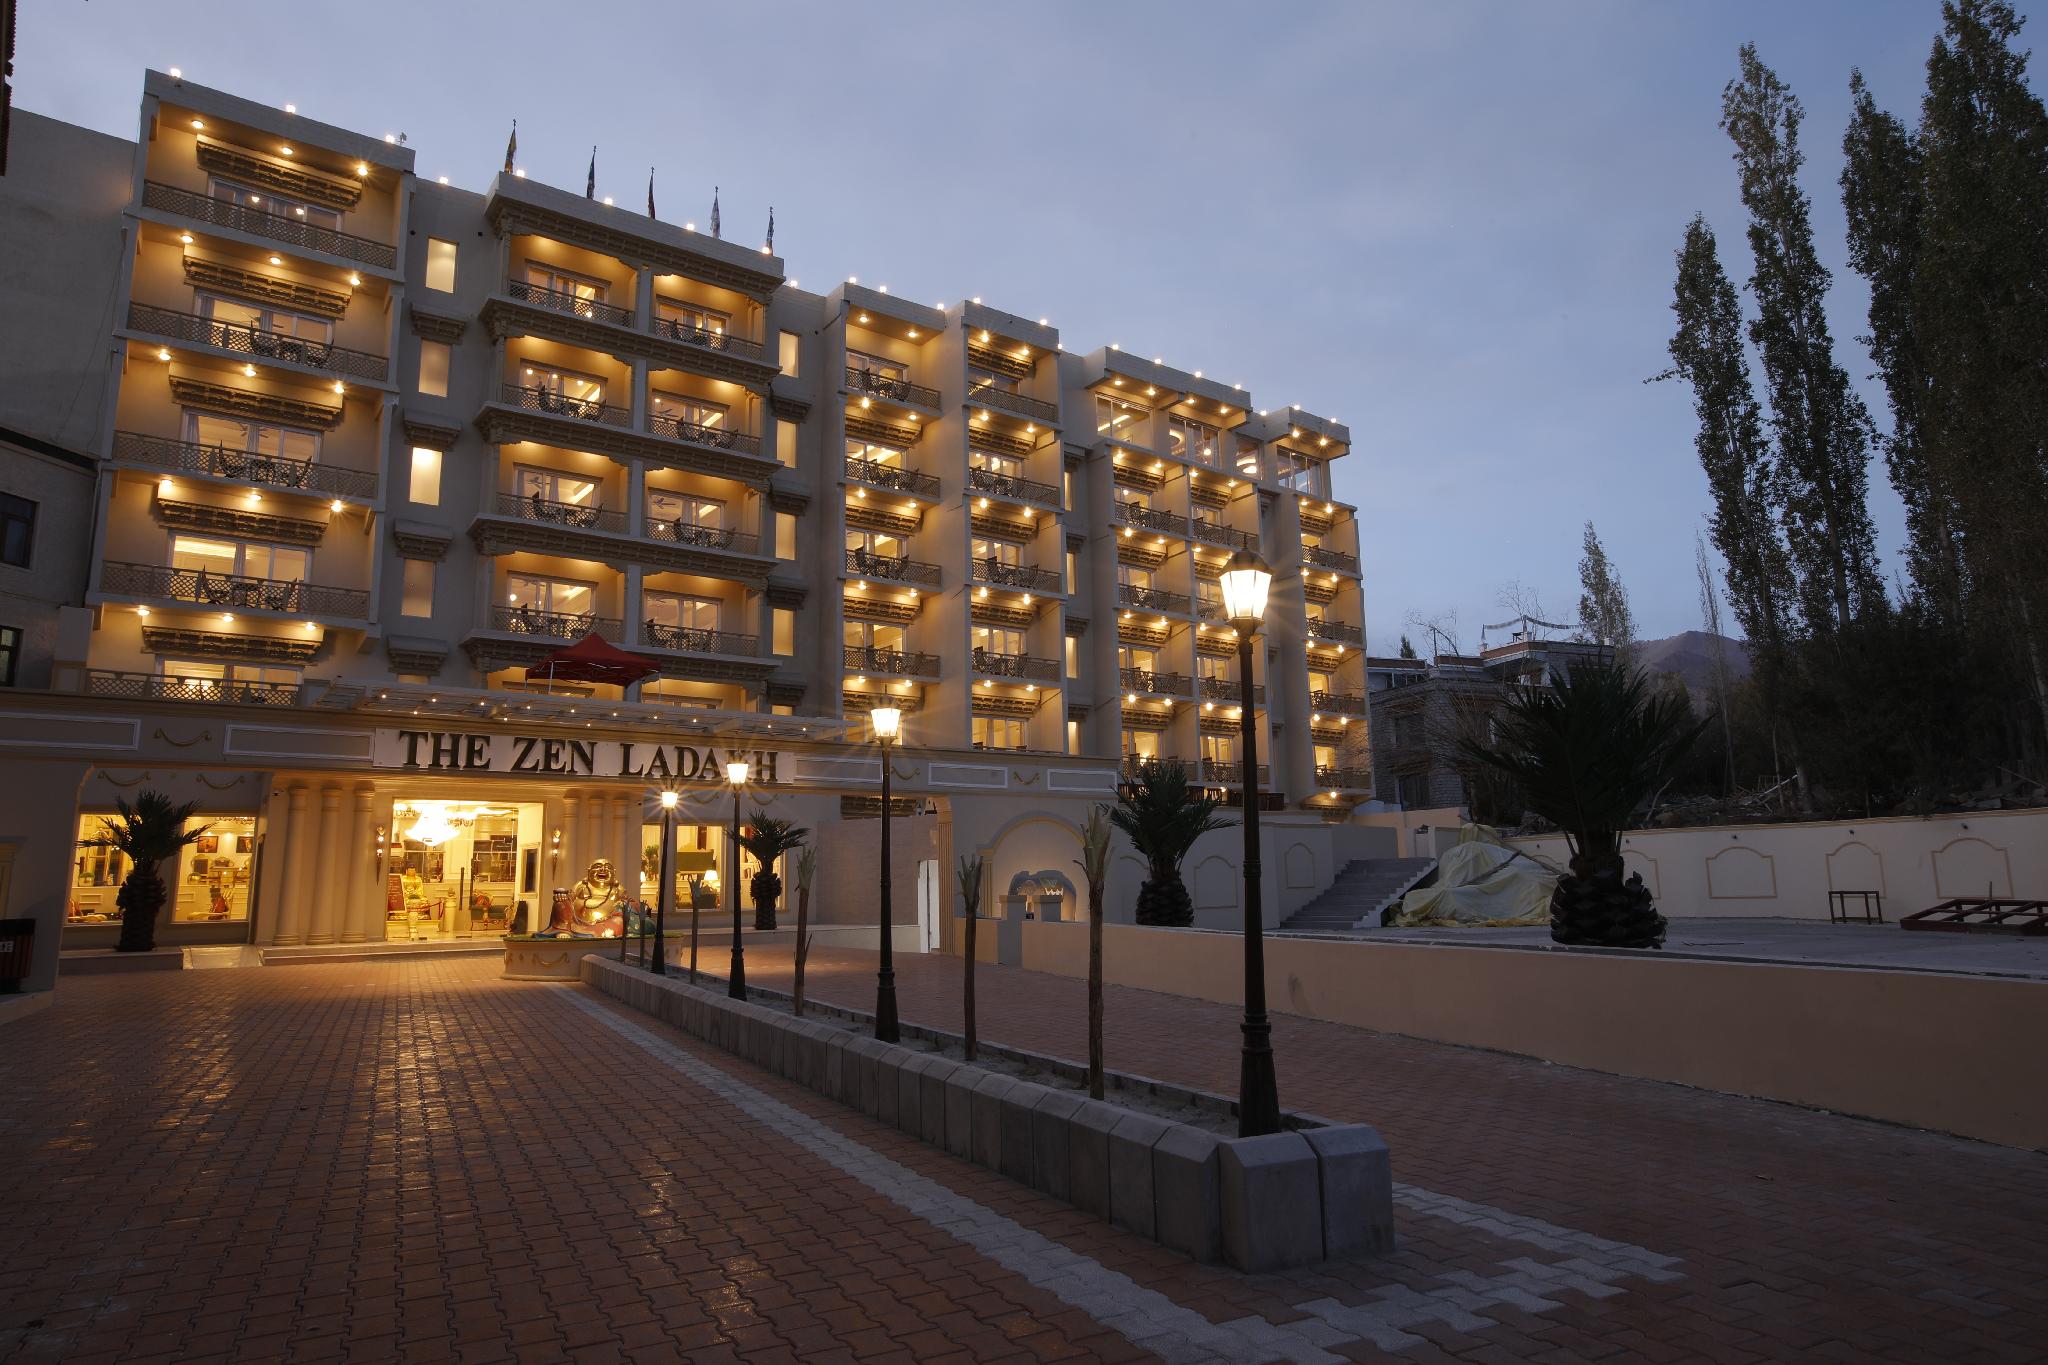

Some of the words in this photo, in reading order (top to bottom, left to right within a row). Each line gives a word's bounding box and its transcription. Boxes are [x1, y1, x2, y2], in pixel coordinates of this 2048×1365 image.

[399, 731, 490, 768] THE
[510, 737, 597, 773] ZEN
[619, 743, 779, 781] LADAH
